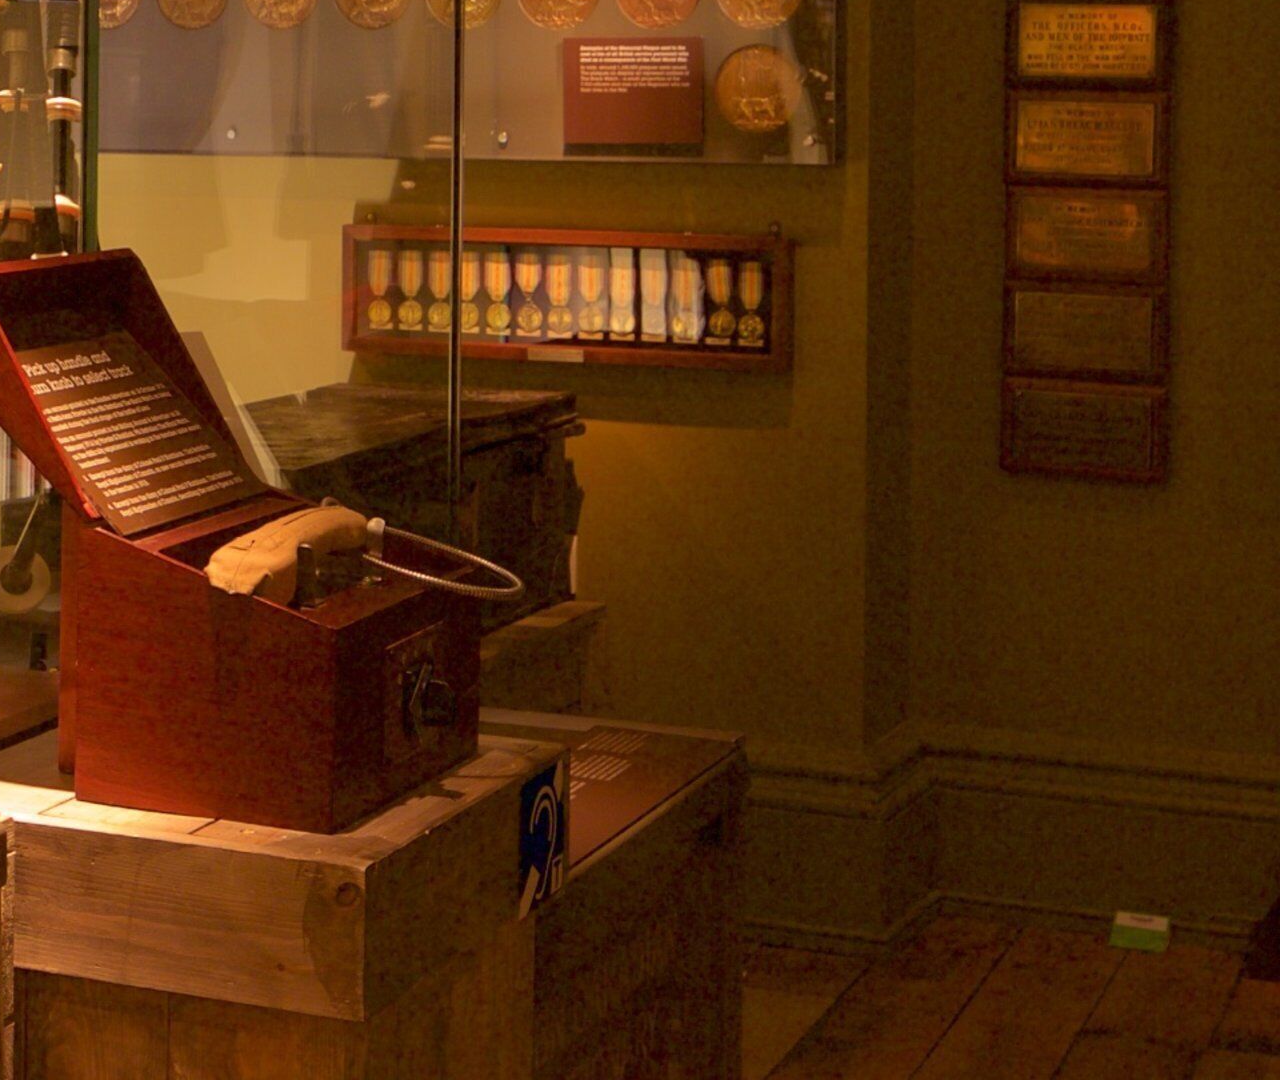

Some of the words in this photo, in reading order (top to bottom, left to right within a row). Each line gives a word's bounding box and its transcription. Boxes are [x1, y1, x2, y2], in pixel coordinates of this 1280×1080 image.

[22, 363, 47, 377] Pick
[44, 362, 60, 374] up
[56, 355, 91, 370] handle
[91, 351, 111, 363] and
[46, 377, 74, 391] knob
[71, 376, 84, 386] to
[83, 370, 110, 384] select
[107, 365, 133, 378] track
